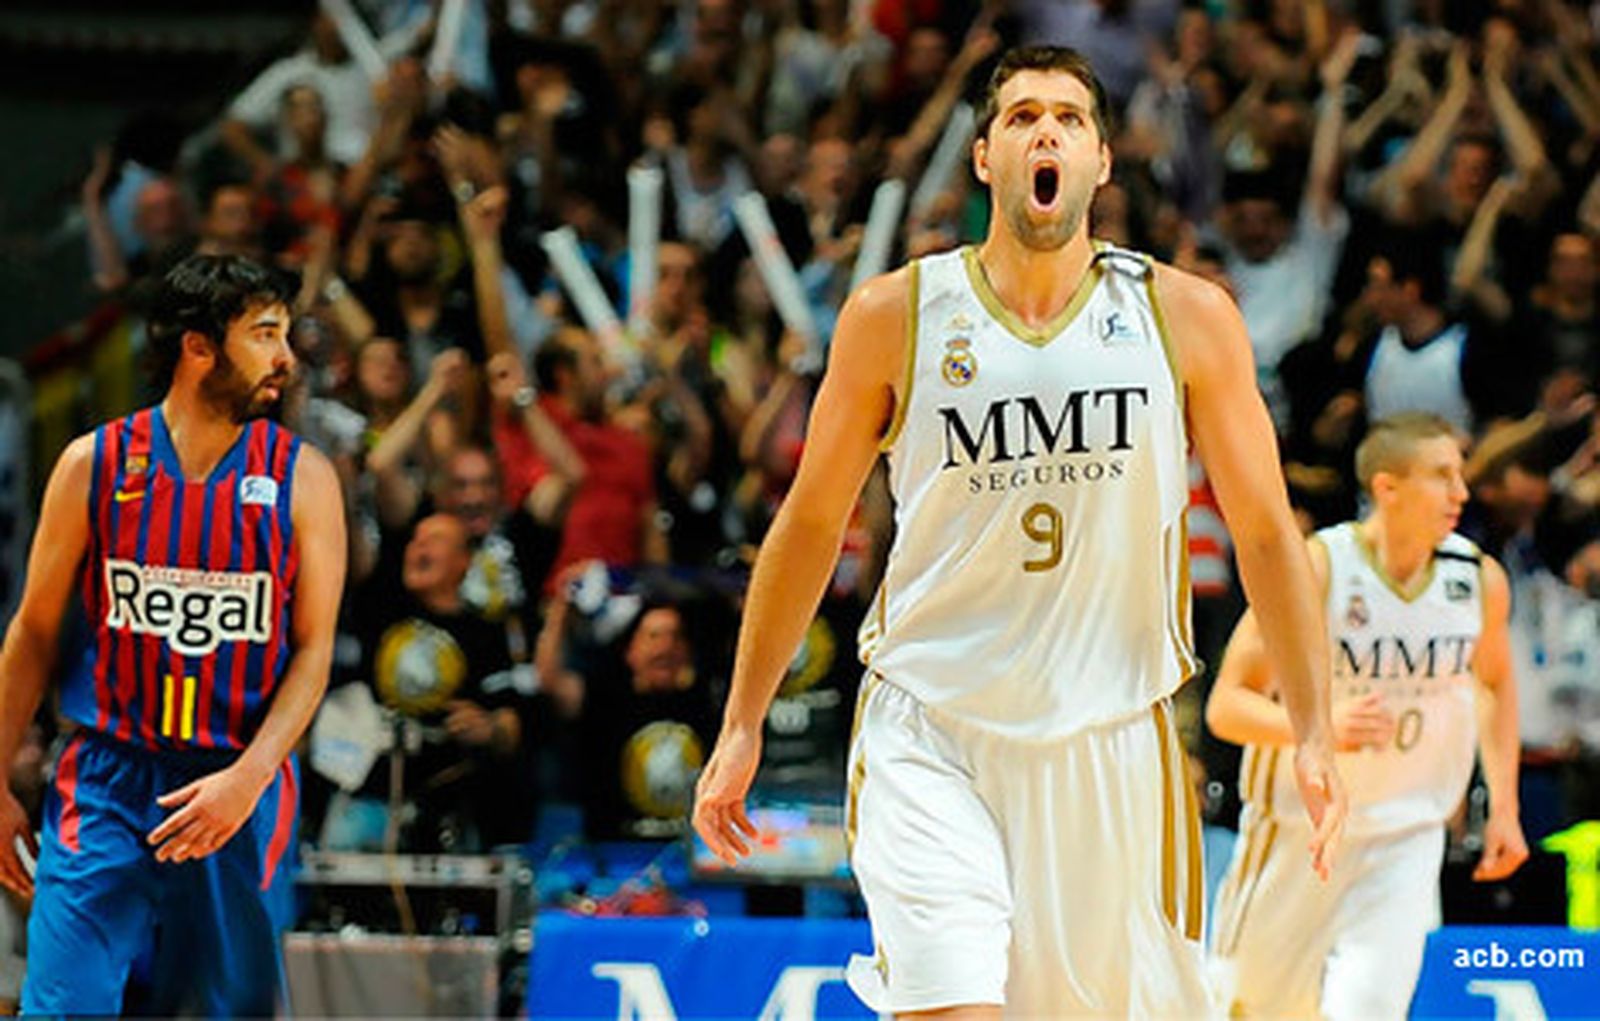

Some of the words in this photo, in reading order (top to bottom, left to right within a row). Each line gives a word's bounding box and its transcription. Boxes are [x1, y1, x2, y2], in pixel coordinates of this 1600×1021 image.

[938, 388, 1148, 469] MMT
[969, 462, 1124, 493] SEGUROS
[1022, 503, 1063, 571] 9
[111, 570, 265, 646] Regal
[1334, 636, 1475, 677] MMT
[162, 675, 196, 740] 11
